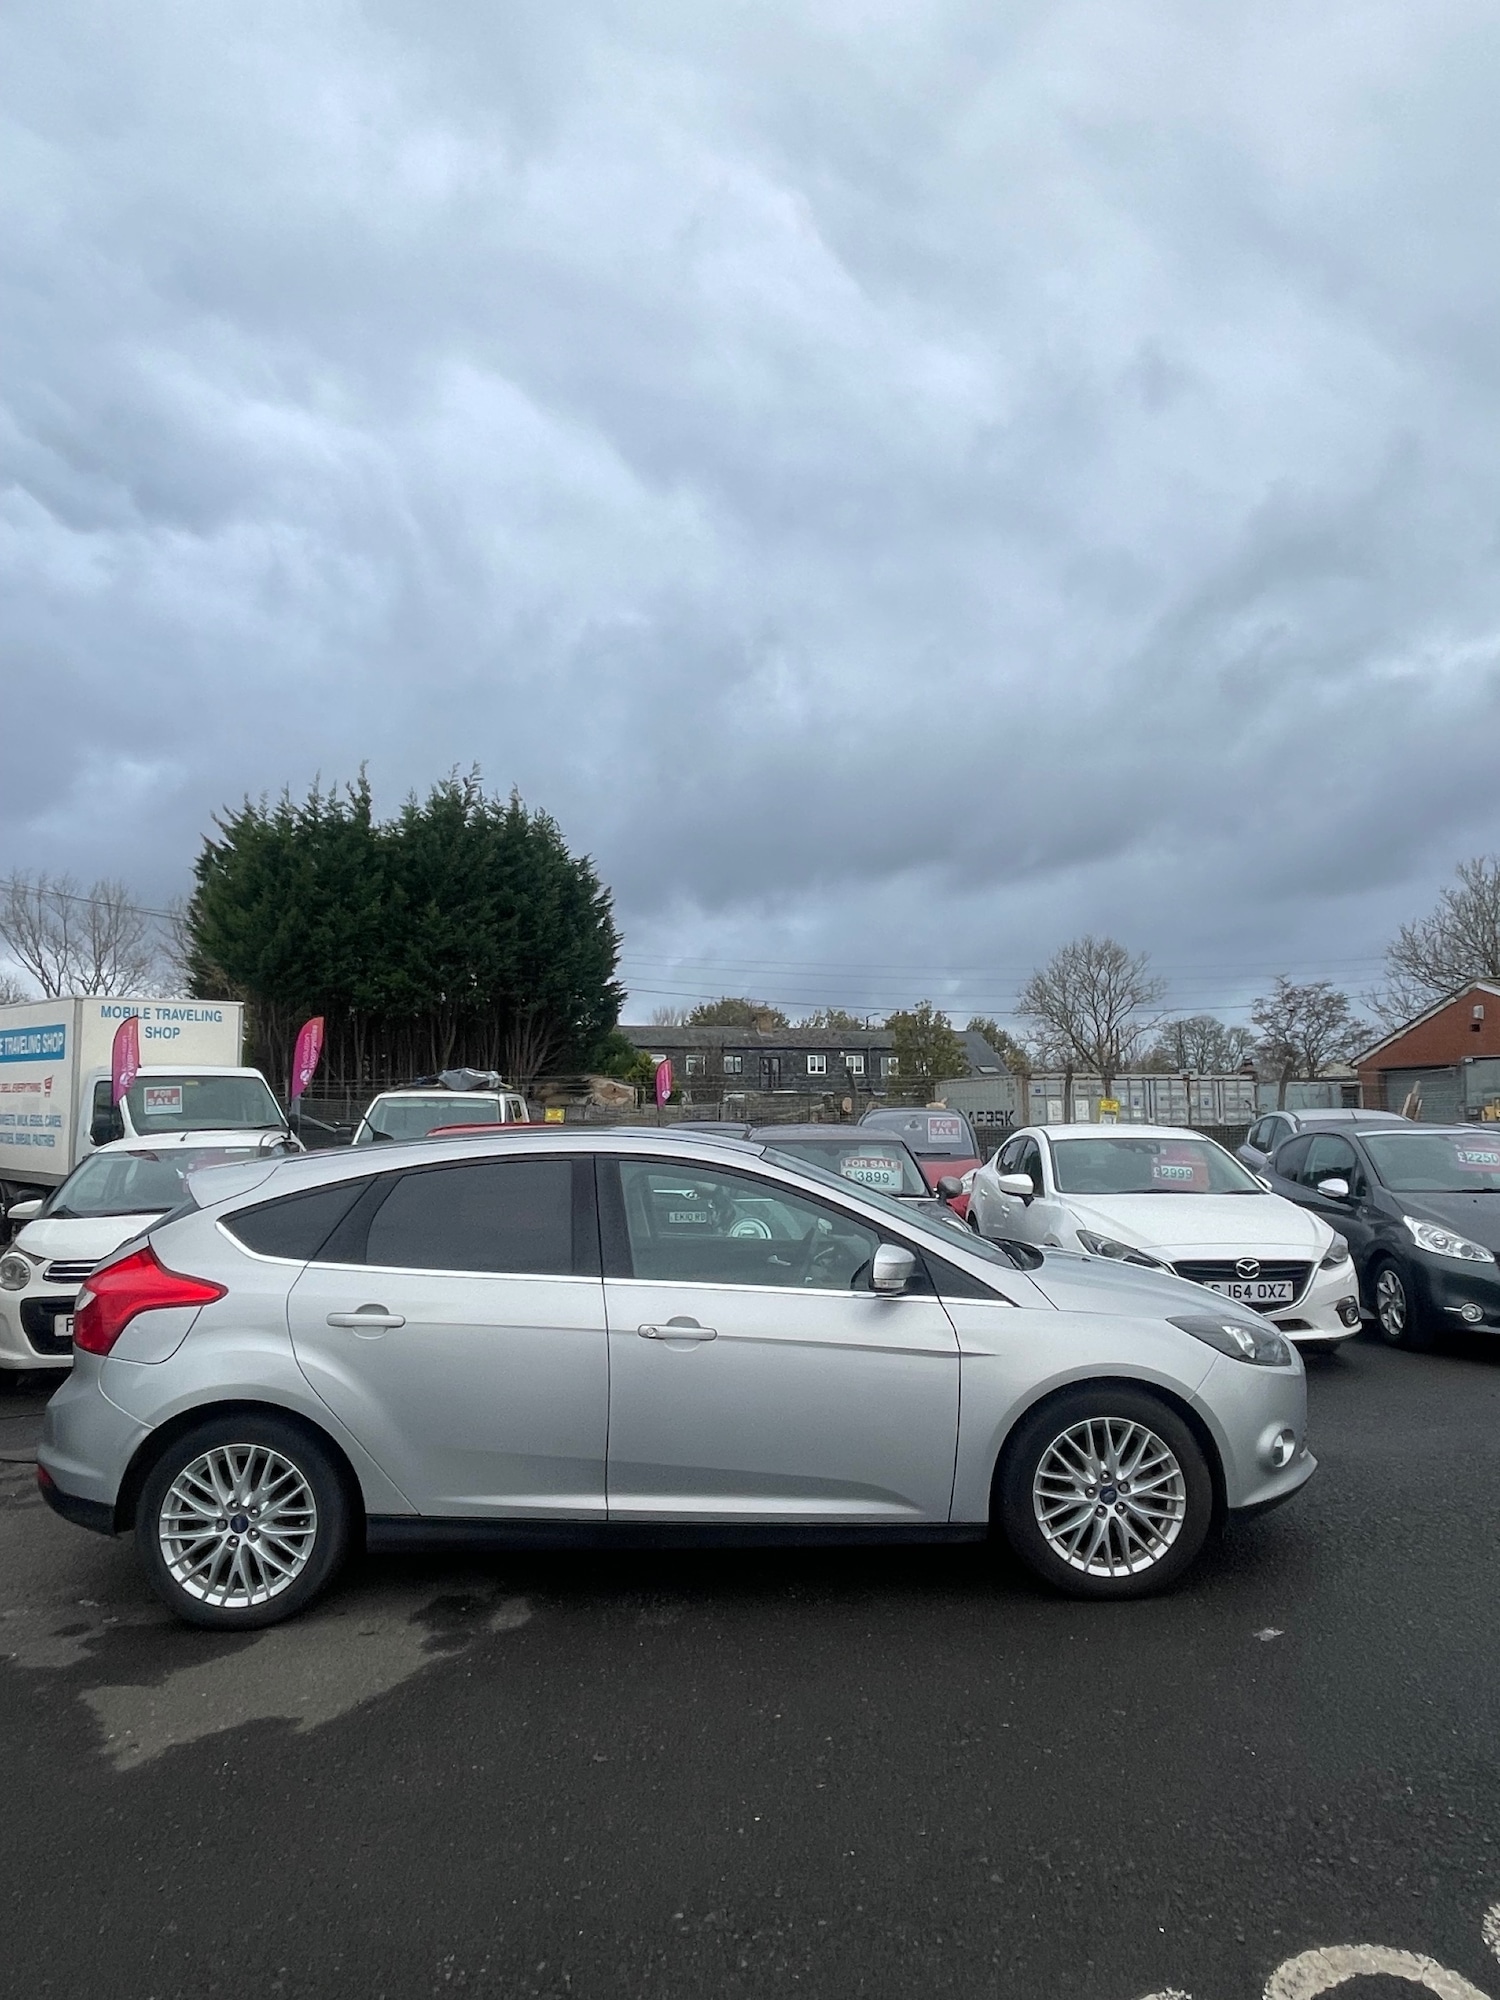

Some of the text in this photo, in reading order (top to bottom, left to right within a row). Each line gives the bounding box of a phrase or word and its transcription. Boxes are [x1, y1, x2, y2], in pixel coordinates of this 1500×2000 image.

[101, 1005, 223, 1022] MOBILE TRAVELING
[144, 1026, 181, 1039] SHOP
[4, 1034, 41, 1056] TRAVELING
[42, 1032, 64, 1053] SHOP
[153, 1090, 172, 1098] FOR
[147, 1097, 179, 1106] SALE
[968, 1110, 1015, 1127] AERSK
[930, 1127, 959, 1135] SALE
[845, 1159, 898, 1169] FOR SALE
[1153, 1167, 1193, 1179] £2999
[1257, 1284, 1287, 1299] OXZ
